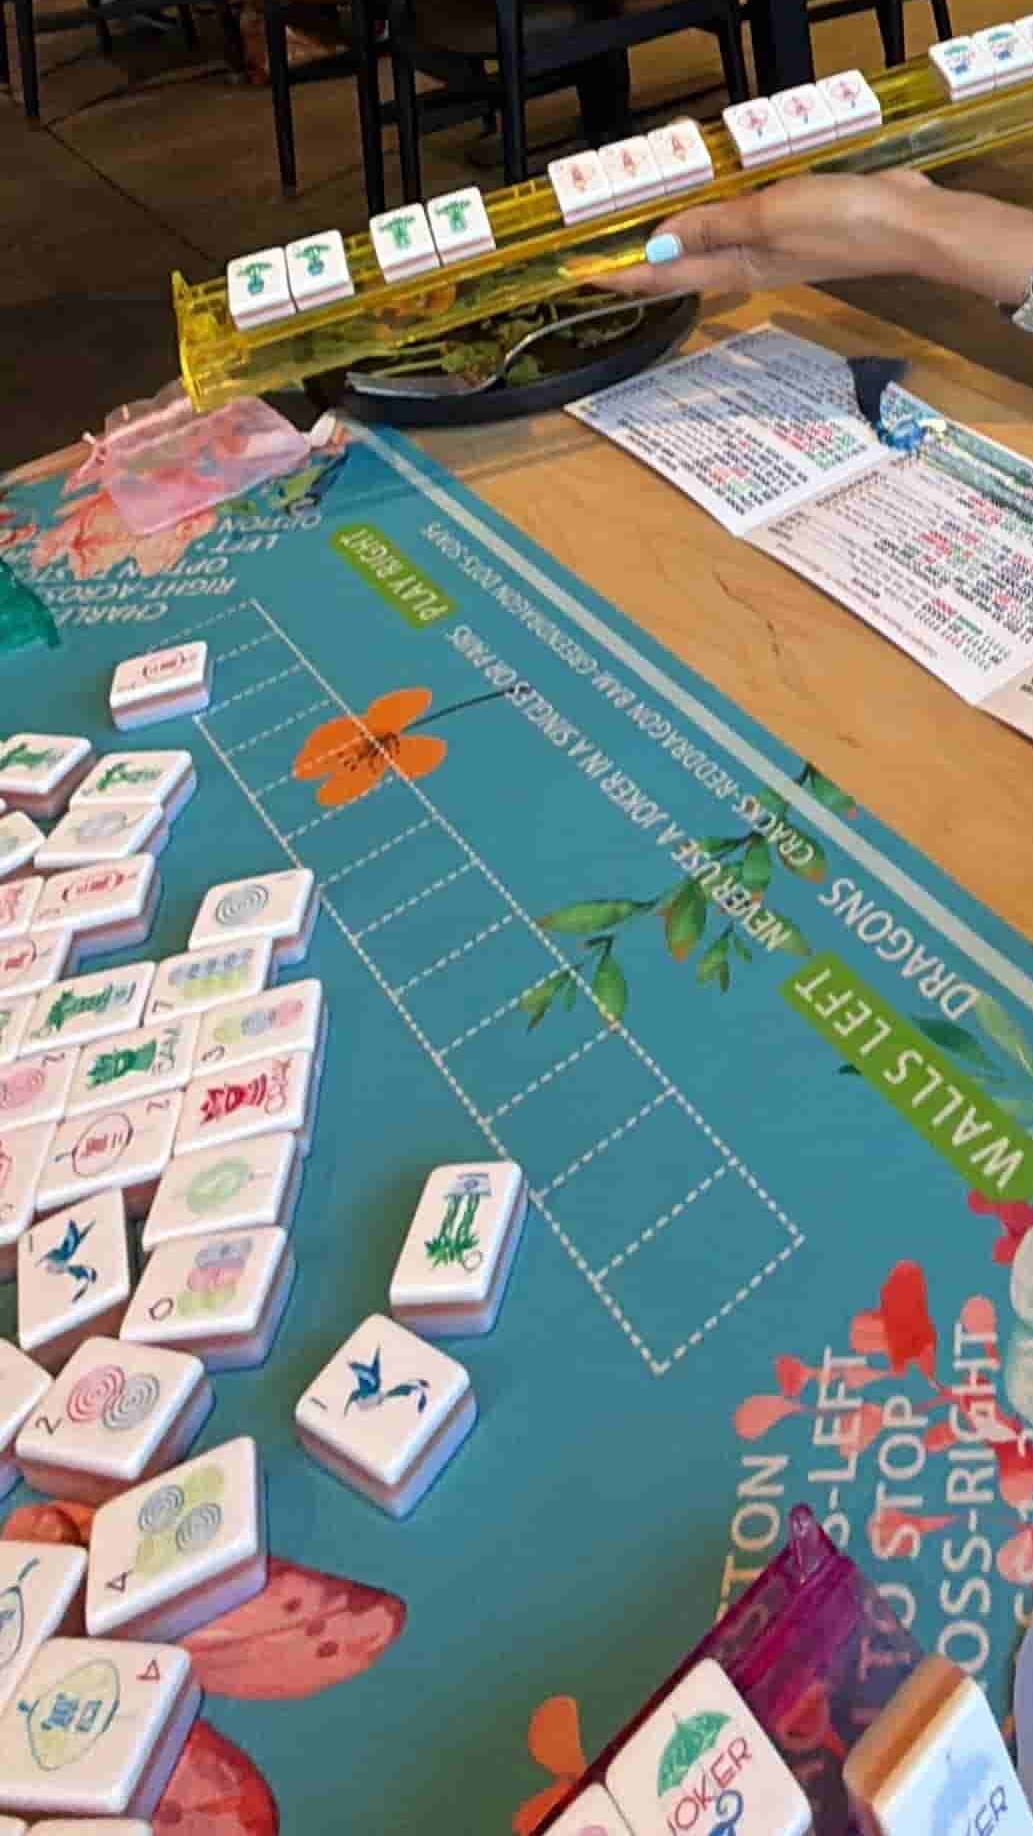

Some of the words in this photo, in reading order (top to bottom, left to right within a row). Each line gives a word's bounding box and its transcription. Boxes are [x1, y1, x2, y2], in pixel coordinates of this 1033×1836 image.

[390, 573, 449, 622] PLAY
[600, 771, 671, 829] JOKER
[656, 822, 685, 845] A
[670, 838, 721, 884] USE
[712, 876, 793, 952] NEVER
[818, 877, 981, 1022] DRAGONS
[795, 968, 892, 1057] LEFT
[882, 1050, 1024, 1191] WALLS
[871, 1395, 930, 1560] STOP
[936, 1322, 1000, 1676] OSS-RIGHT
